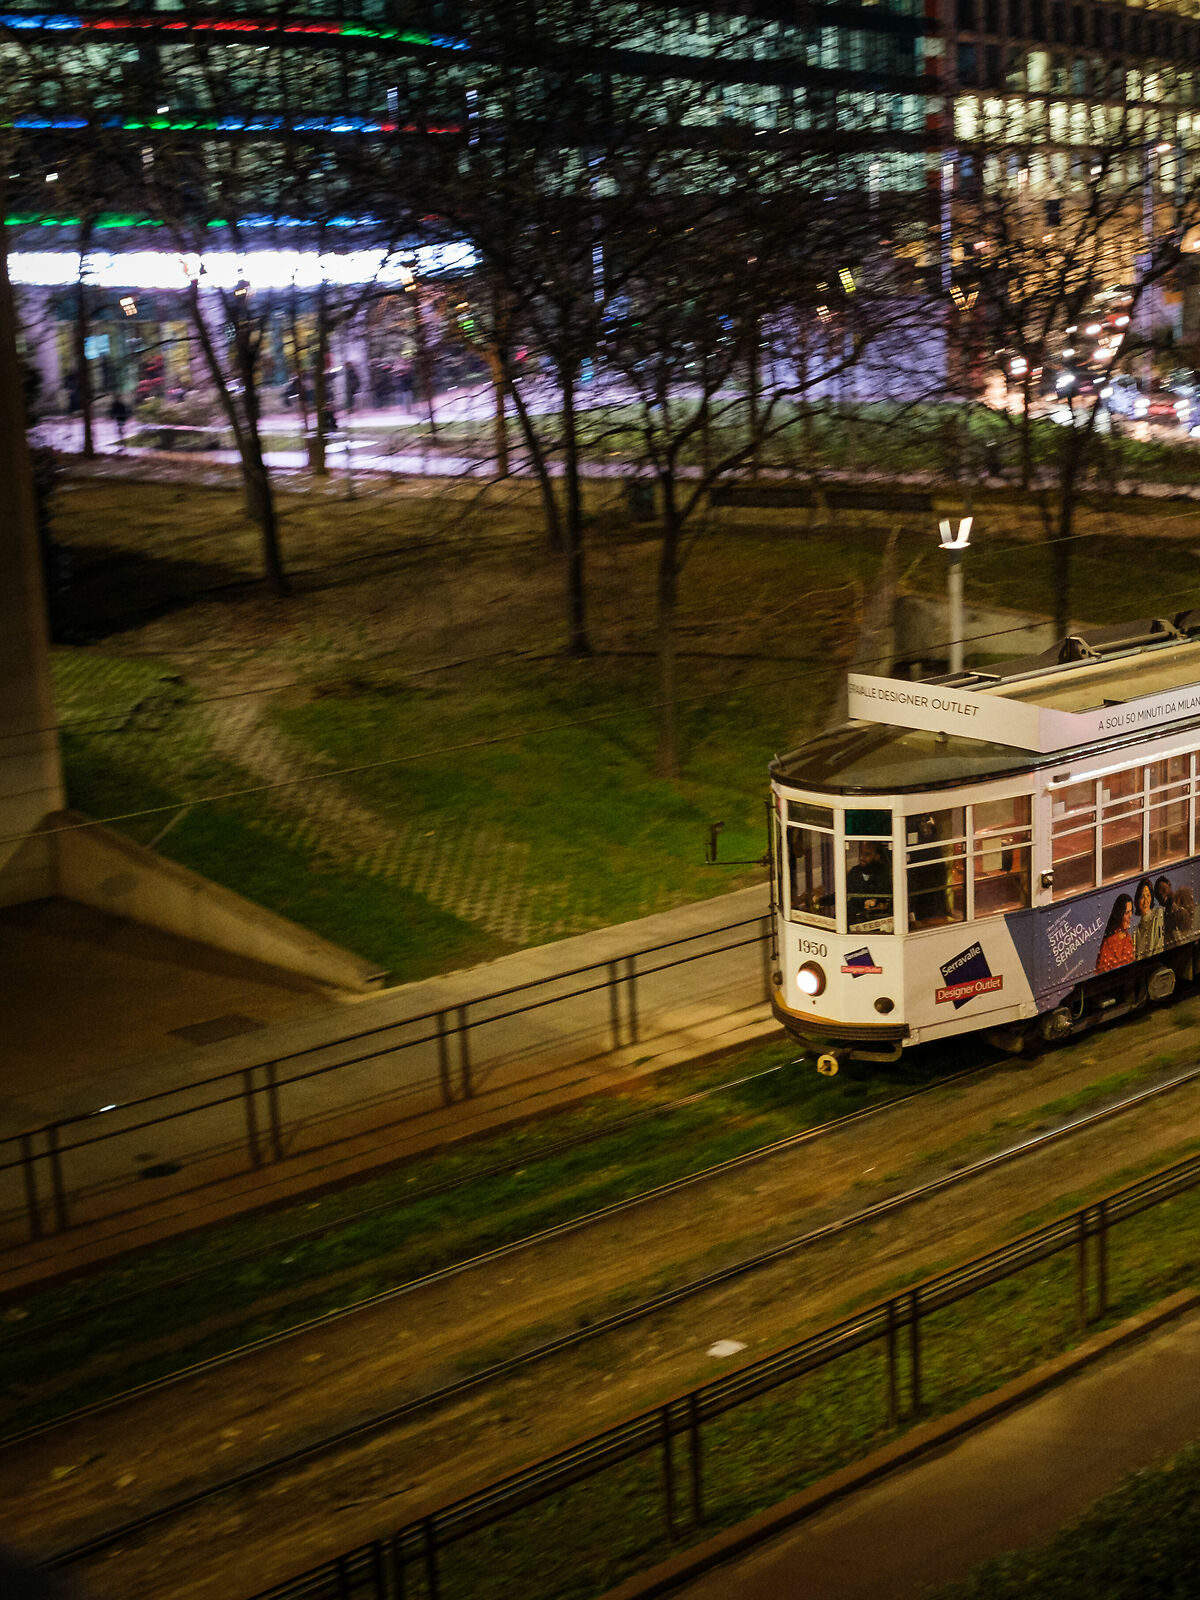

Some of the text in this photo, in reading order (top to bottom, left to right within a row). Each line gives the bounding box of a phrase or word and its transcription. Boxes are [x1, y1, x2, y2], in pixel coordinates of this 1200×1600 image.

[878, 689, 929, 708] DESIGNER
[931, 698, 980, 717] OUTLET
[1098, 720, 1105, 731] A
[1106, 716, 1125, 729] SOLI
[1126, 712, 1136, 724] 50
[1137, 705, 1164, 721] MINUTI
[1165, 702, 1177, 714] DA
[798, 938, 828, 958] 1950
[1049, 921, 1073, 947] STILE.
[1052, 923, 1086, 957] SOGNO.
[1055, 917, 1105, 967] SERRAVALLE.
[942, 946, 981, 977] Serravalle
[937, 979, 1001, 1000] Designer Outlet
